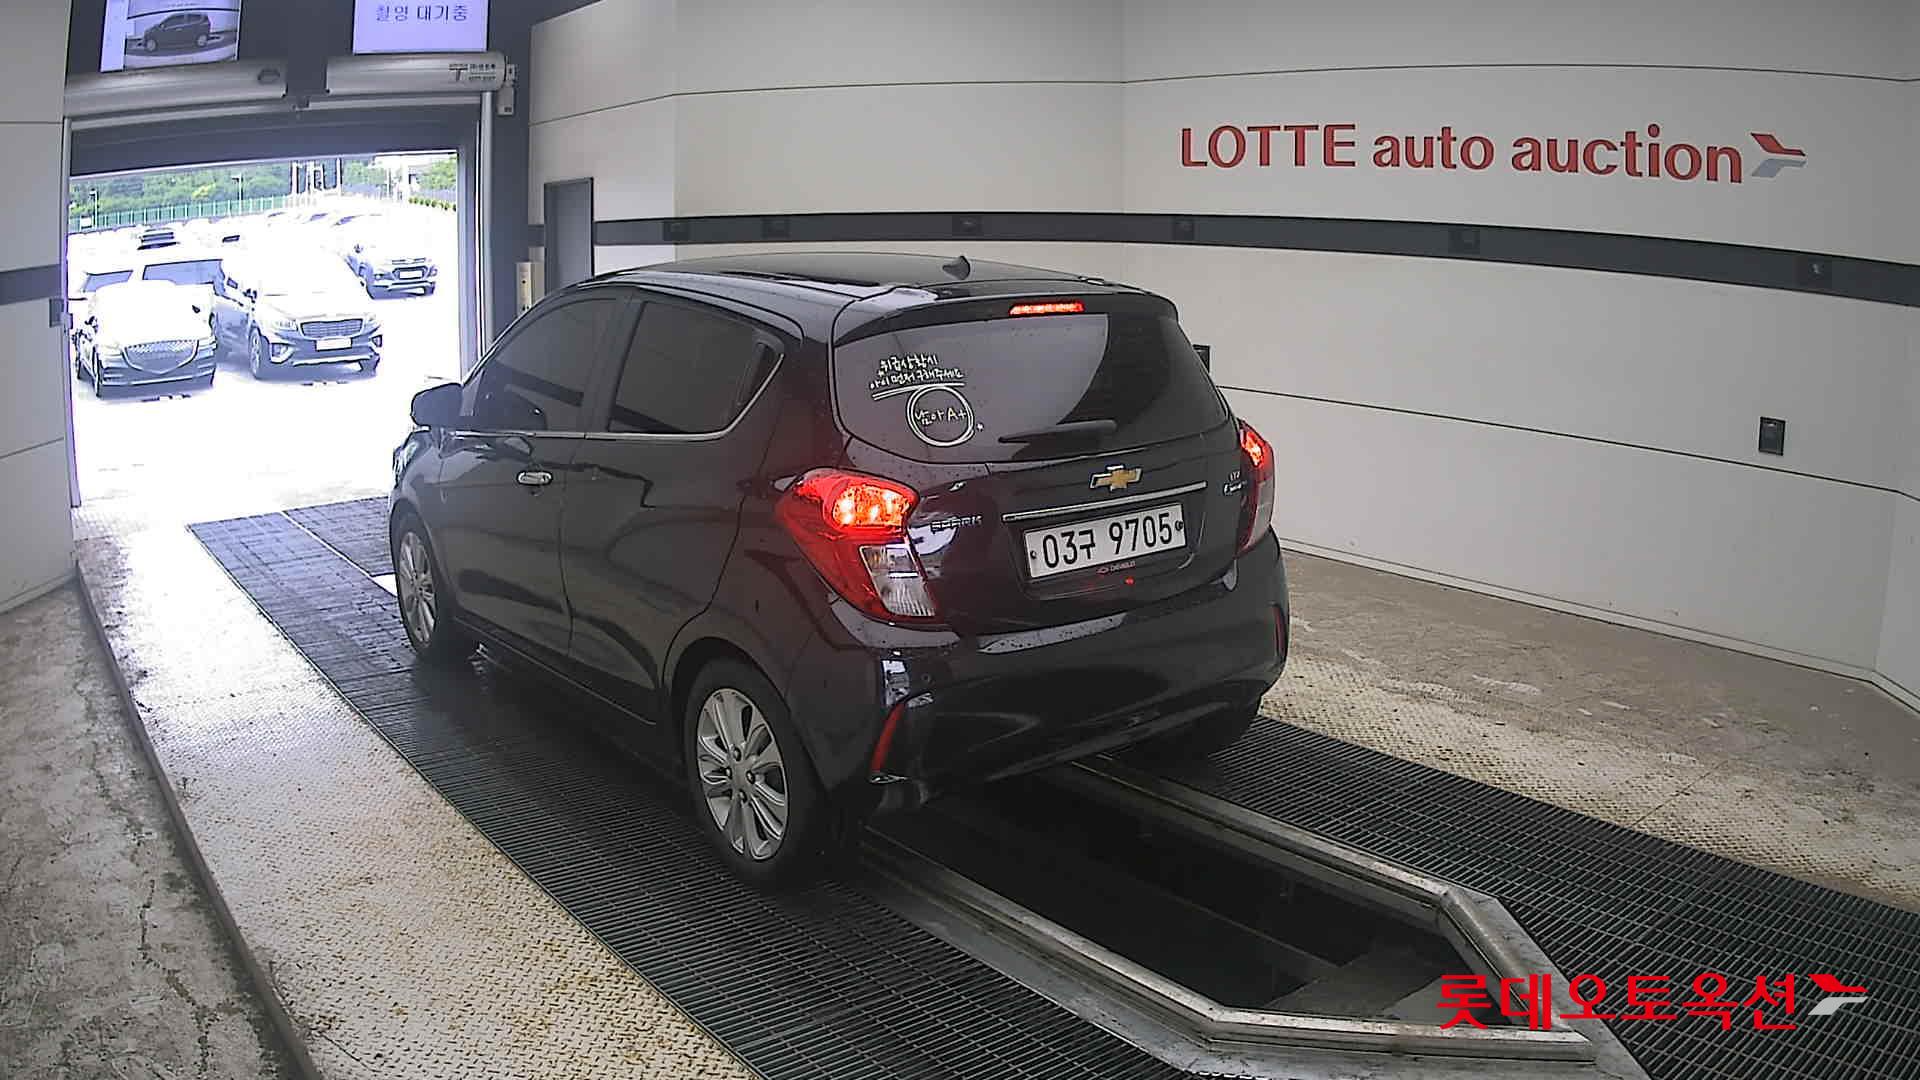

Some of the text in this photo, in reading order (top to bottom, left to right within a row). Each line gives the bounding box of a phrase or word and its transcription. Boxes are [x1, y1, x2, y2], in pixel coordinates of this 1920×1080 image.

[416, 3, 467, 21] 대기중
[1181, 123, 1744, 184] LOTTE auto auction
[946, 407, 967, 422] A+
[1042, 513, 1173, 568] 03구 9705
